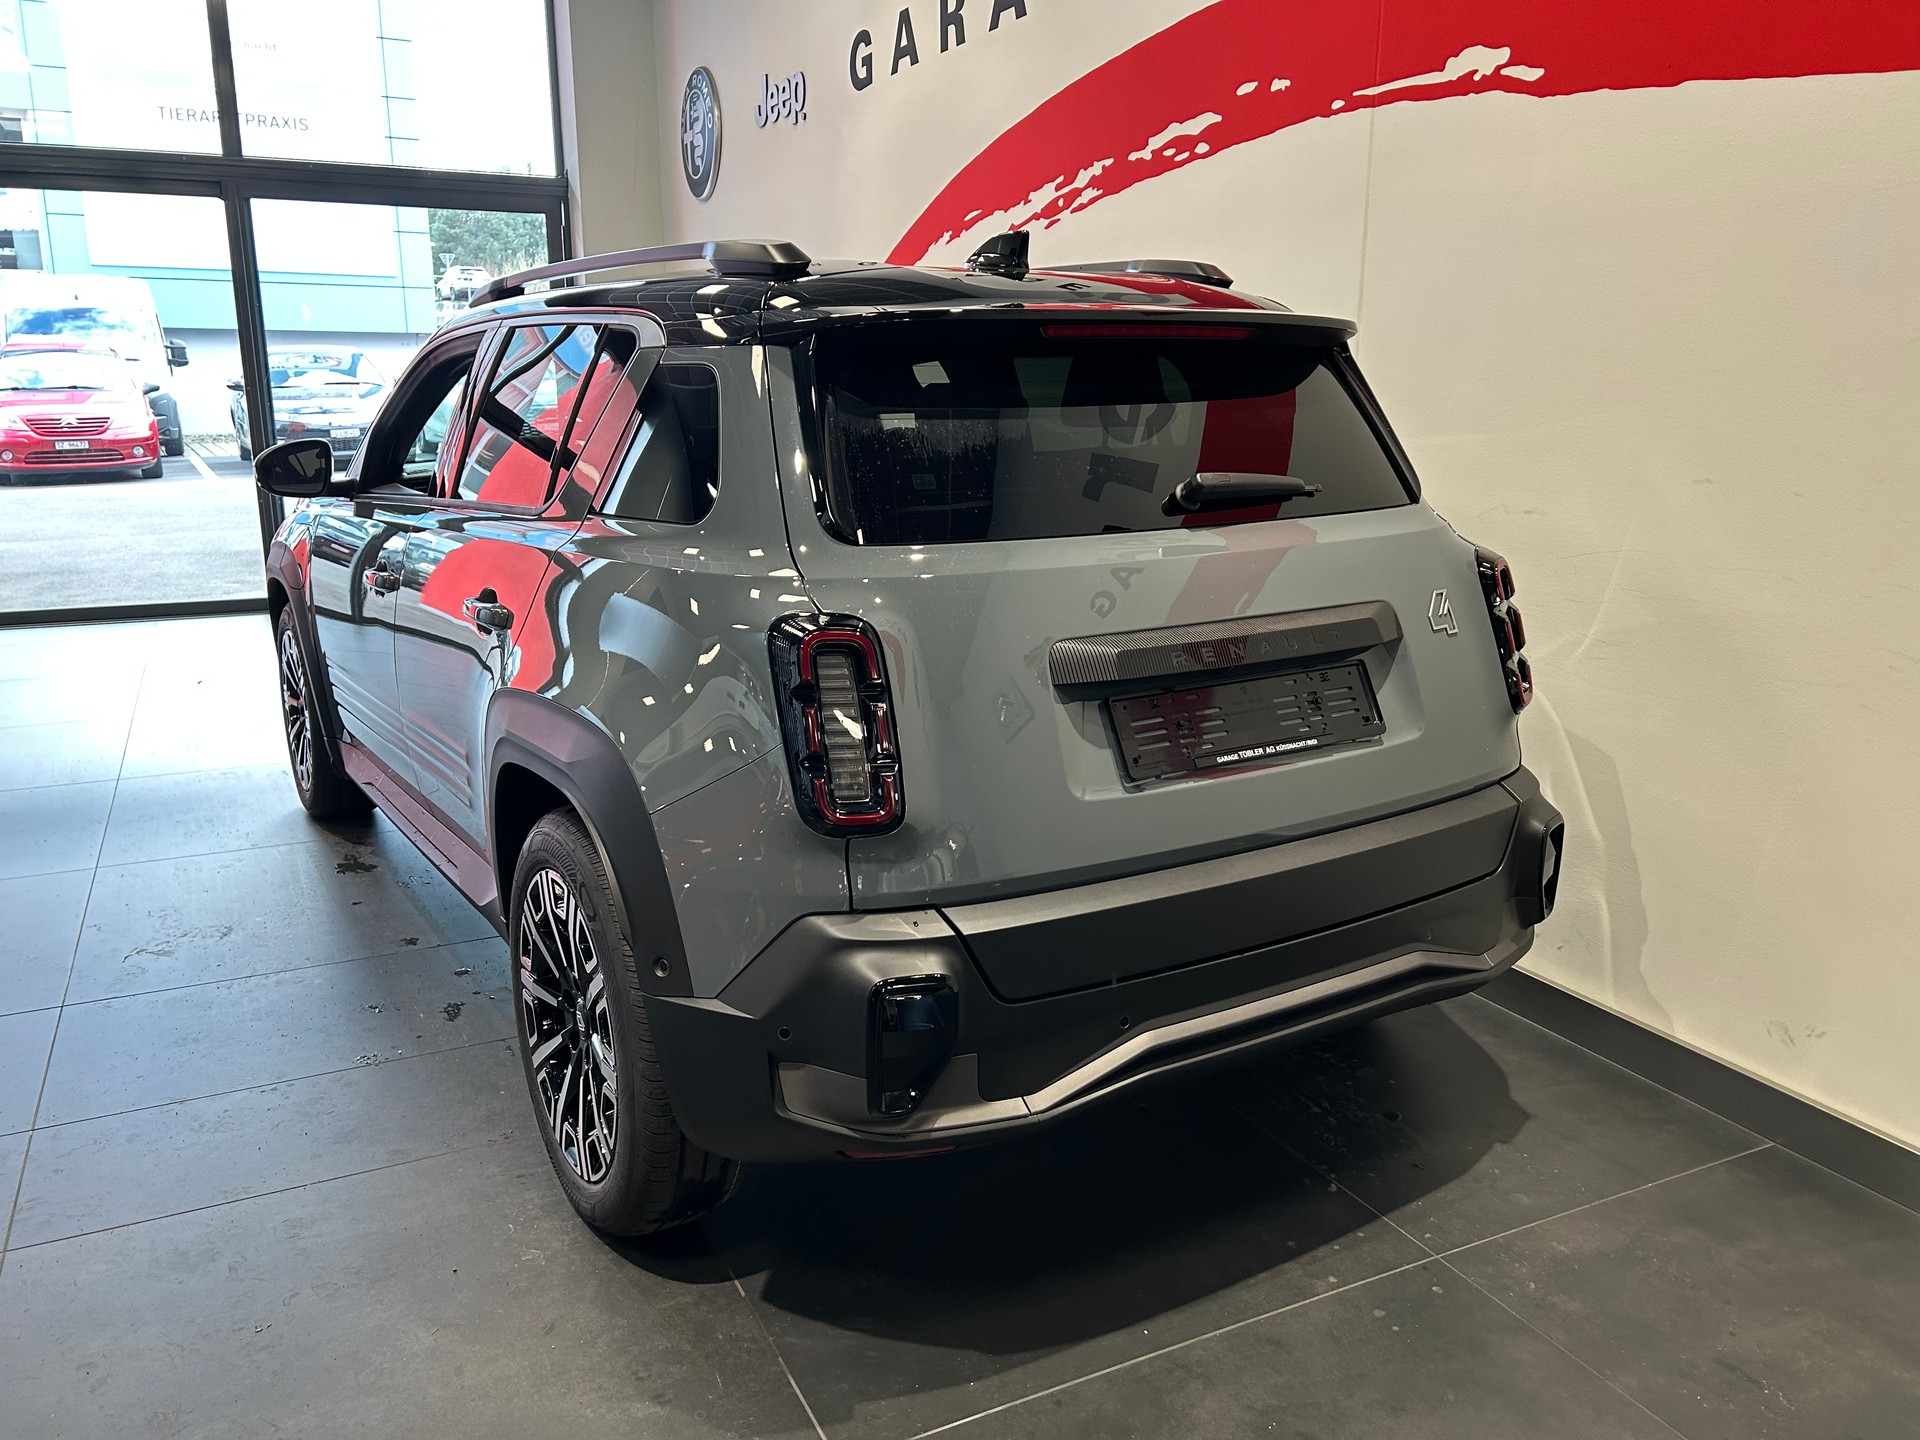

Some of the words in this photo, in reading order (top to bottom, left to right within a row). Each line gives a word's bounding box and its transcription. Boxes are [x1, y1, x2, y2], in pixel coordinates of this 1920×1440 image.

[691, 74, 713, 129] ROMEO
[158, 105, 309, 131] TIERARPRAXIS
[1169, 629, 1341, 668] RENAULT
[1216, 753, 1239, 762] GARAGE
[1239, 747, 1264, 758] TOBLER
[1265, 745, 1276, 753] AG
